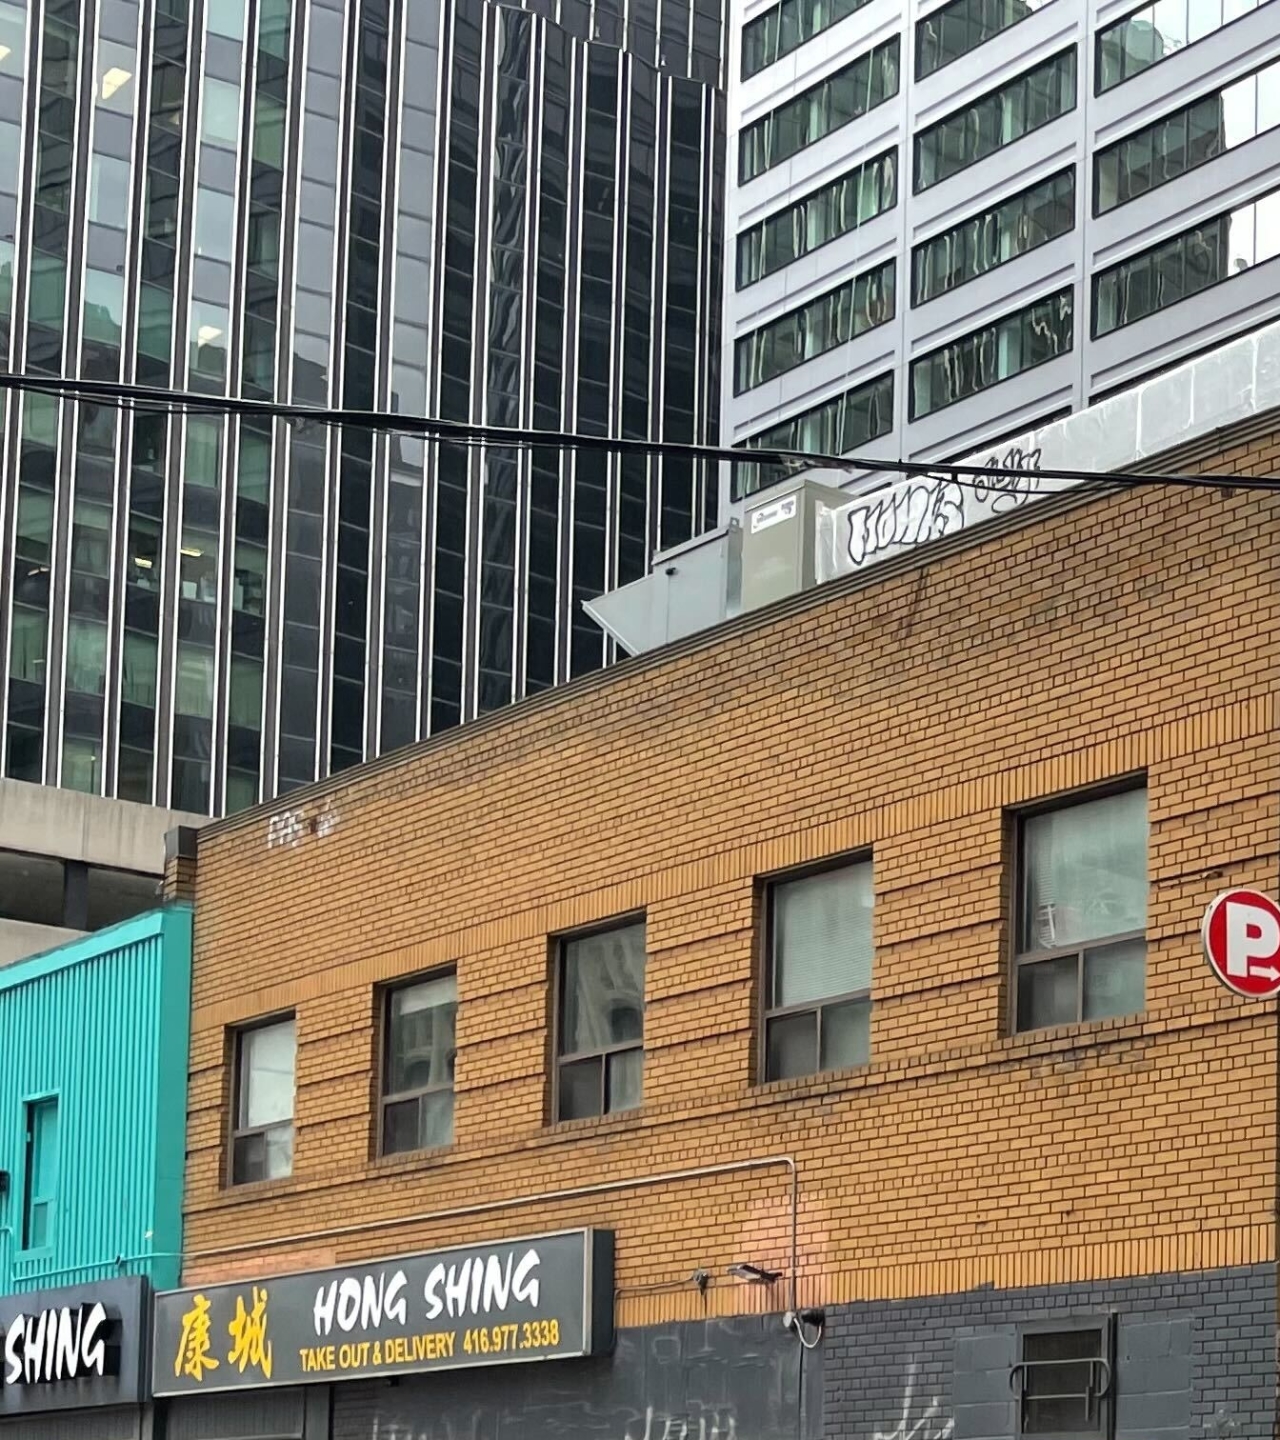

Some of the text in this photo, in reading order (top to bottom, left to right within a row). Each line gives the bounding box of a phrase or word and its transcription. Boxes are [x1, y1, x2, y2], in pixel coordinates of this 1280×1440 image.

[174, 1286, 273, 1382] 康城
[313, 1248, 542, 1336] HONG SHING
[5, 1303, 107, 1384] SHING
[300, 1319, 560, 1372] TAKE OUT & DELIVERY 416.977.3338
